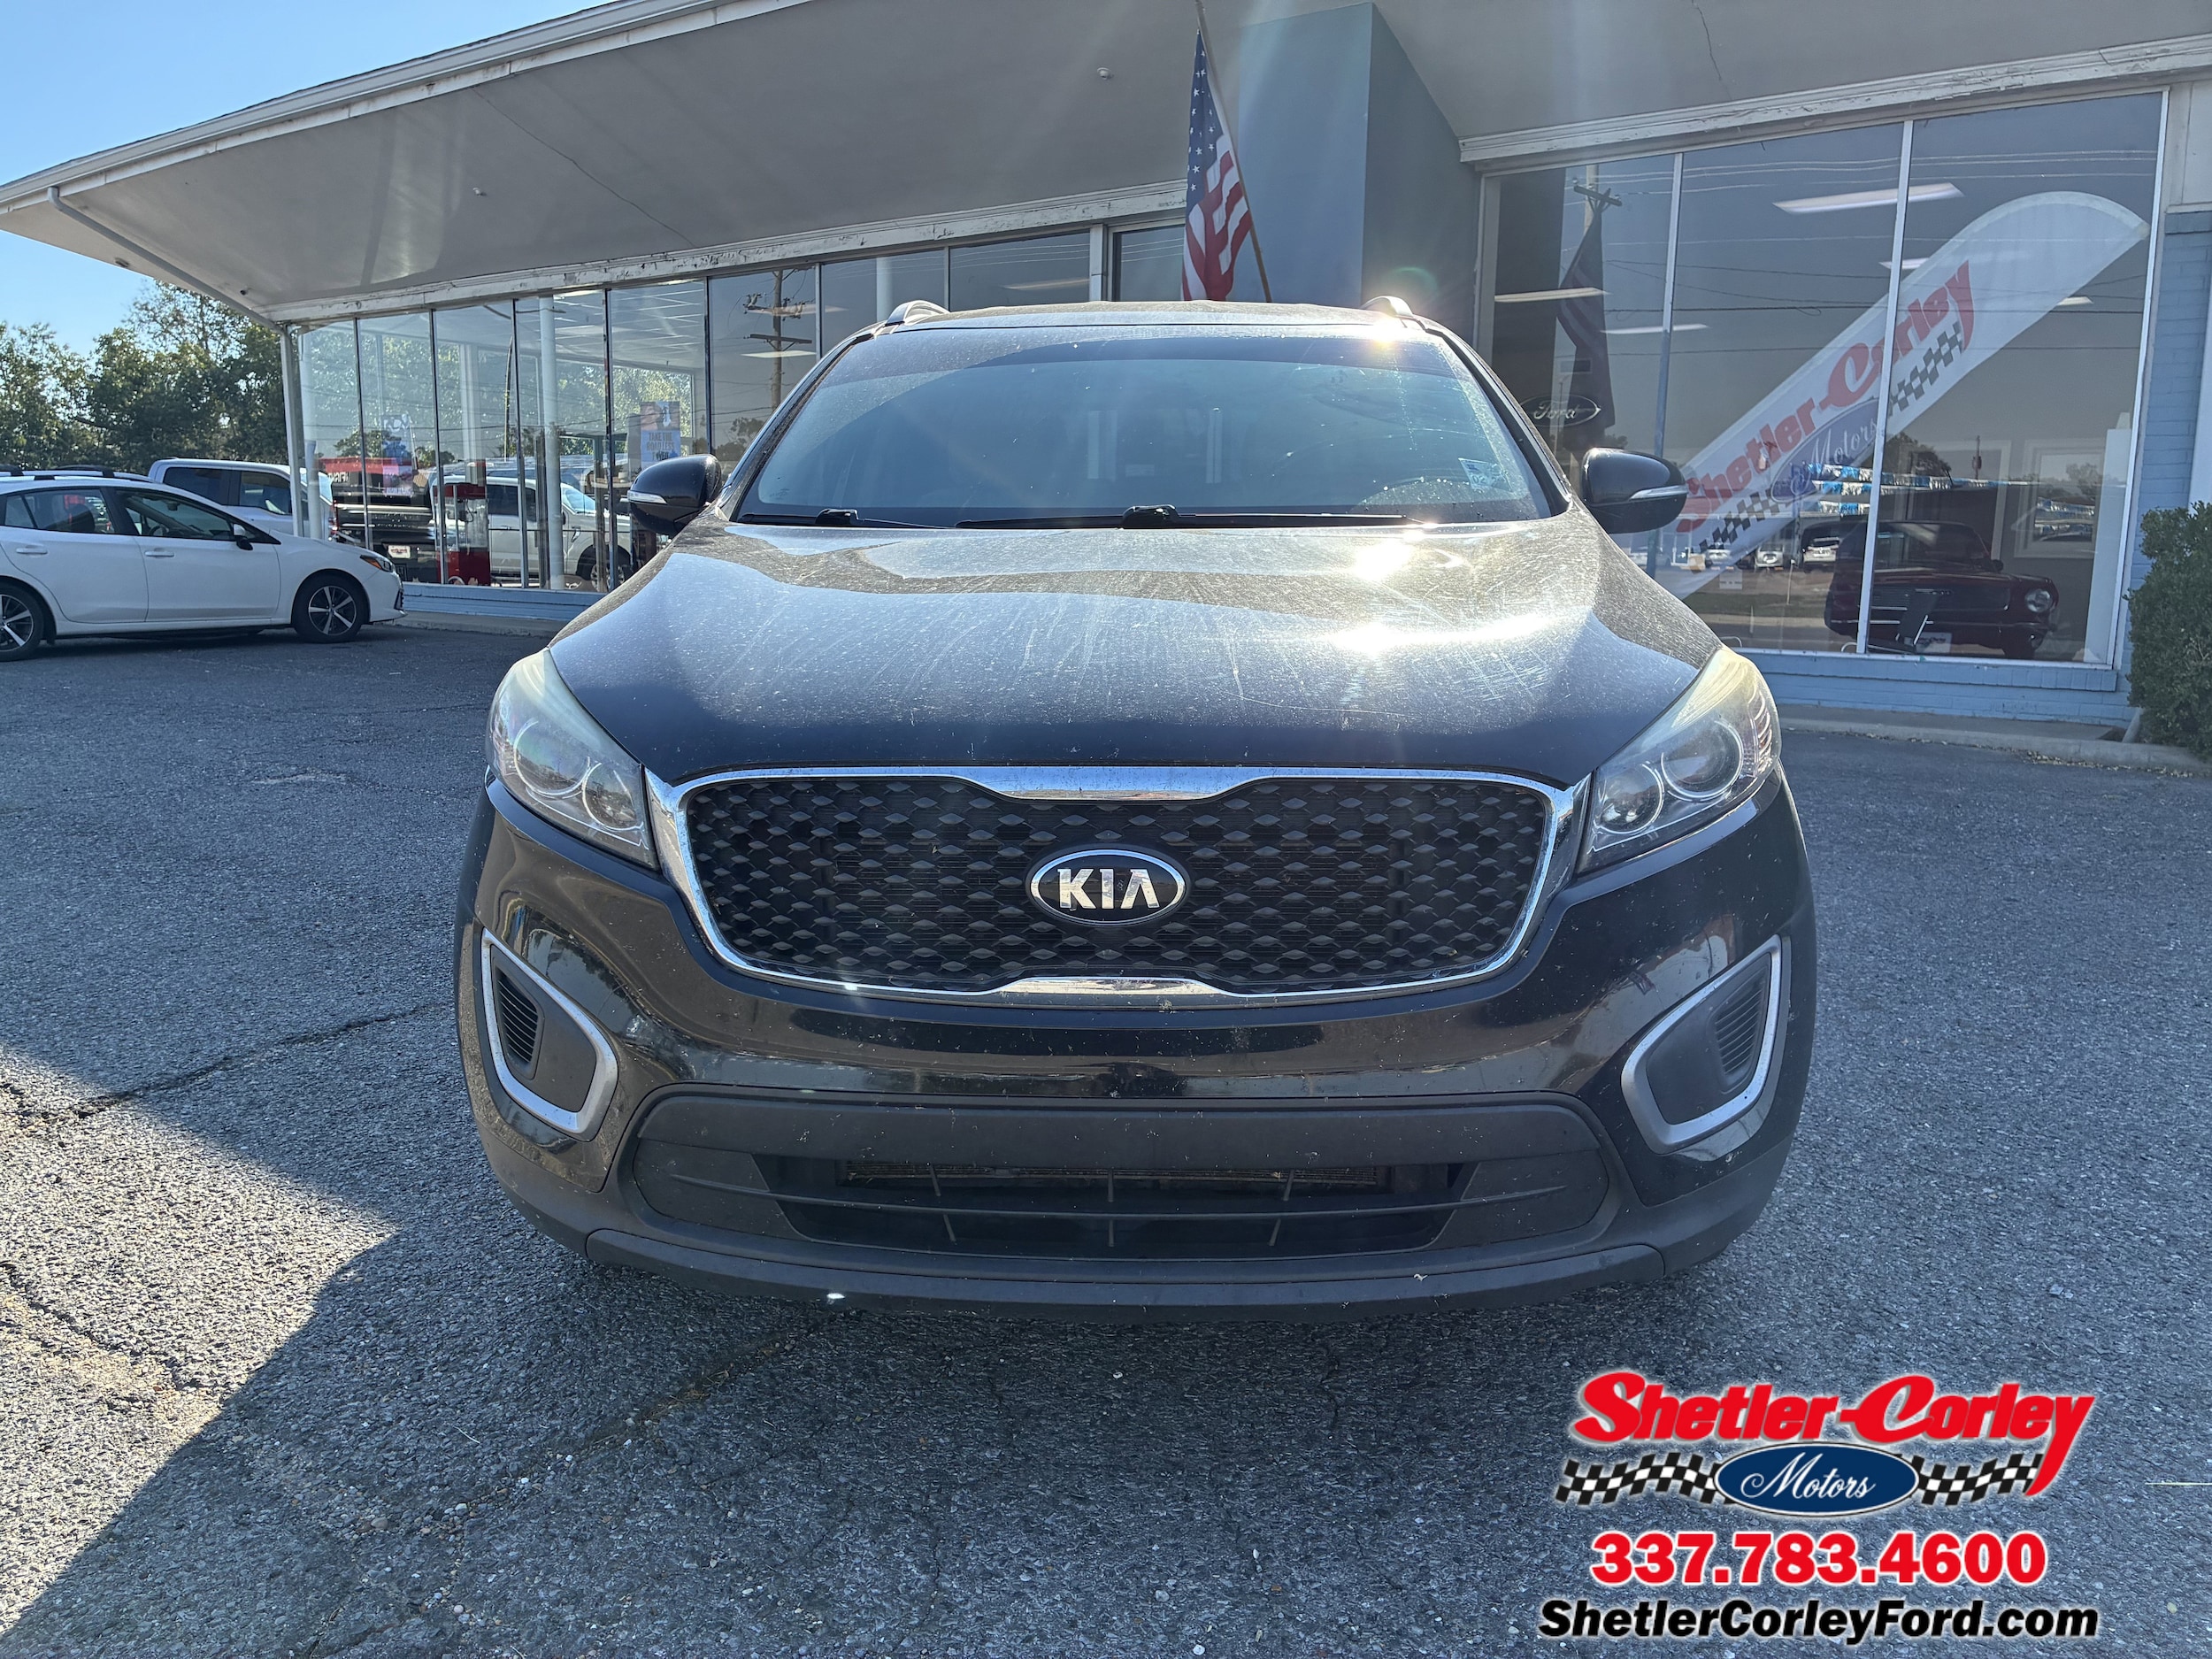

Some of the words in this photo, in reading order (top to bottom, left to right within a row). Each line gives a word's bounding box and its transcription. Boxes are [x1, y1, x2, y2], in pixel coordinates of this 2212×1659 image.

[1533, 400, 1579, 419] Ford
[1789, 418, 1878, 493] Motors
[1057, 869, 1160, 909] KIA
